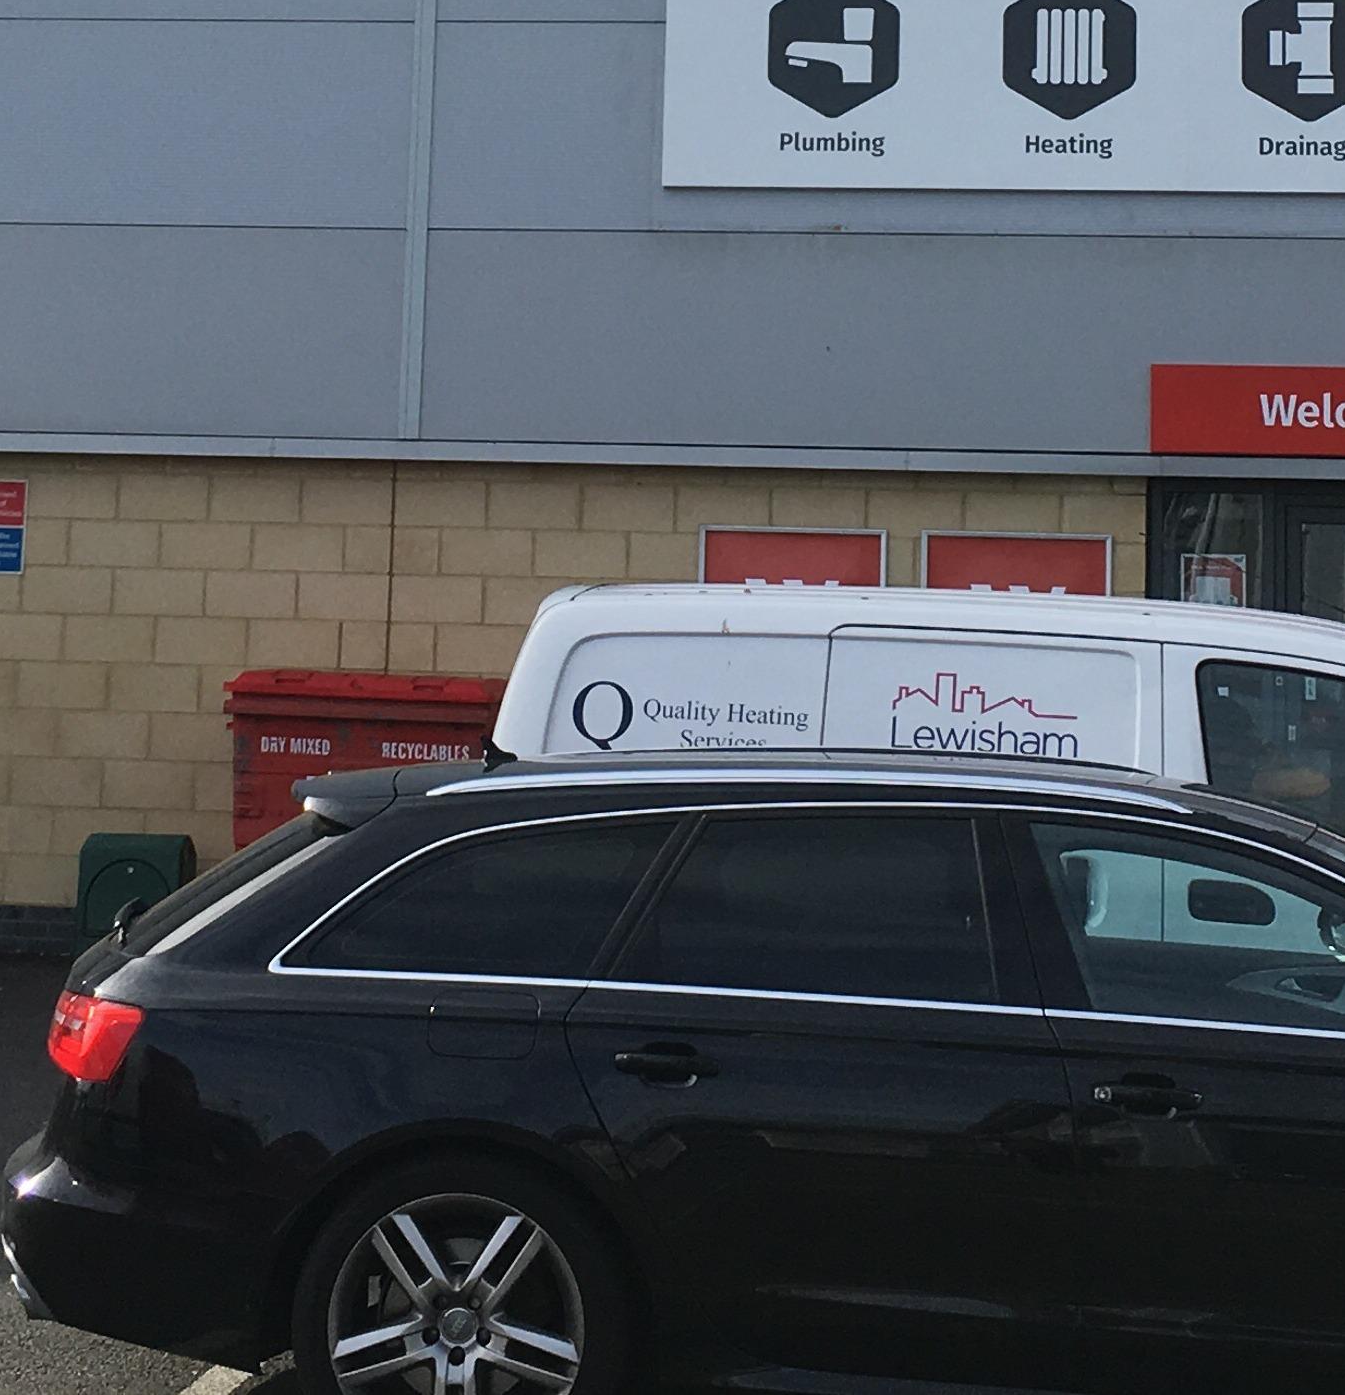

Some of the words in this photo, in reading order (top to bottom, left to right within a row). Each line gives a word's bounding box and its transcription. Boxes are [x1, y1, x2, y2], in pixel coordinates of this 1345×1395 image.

[779, 131, 886, 158] Plumbing
[1024, 133, 1114, 160] Heating
[572, 680, 633, 750] Q
[643, 698, 721, 726] Quality
[726, 703, 809, 732] Heating
[260, 736, 286, 754] DRY
[289, 737, 331, 756] MIXED
[679, 729, 767, 749] Services
[891, 715, 1078, 758] Lewisham
[381, 742, 470, 761] RECYCLABLES
